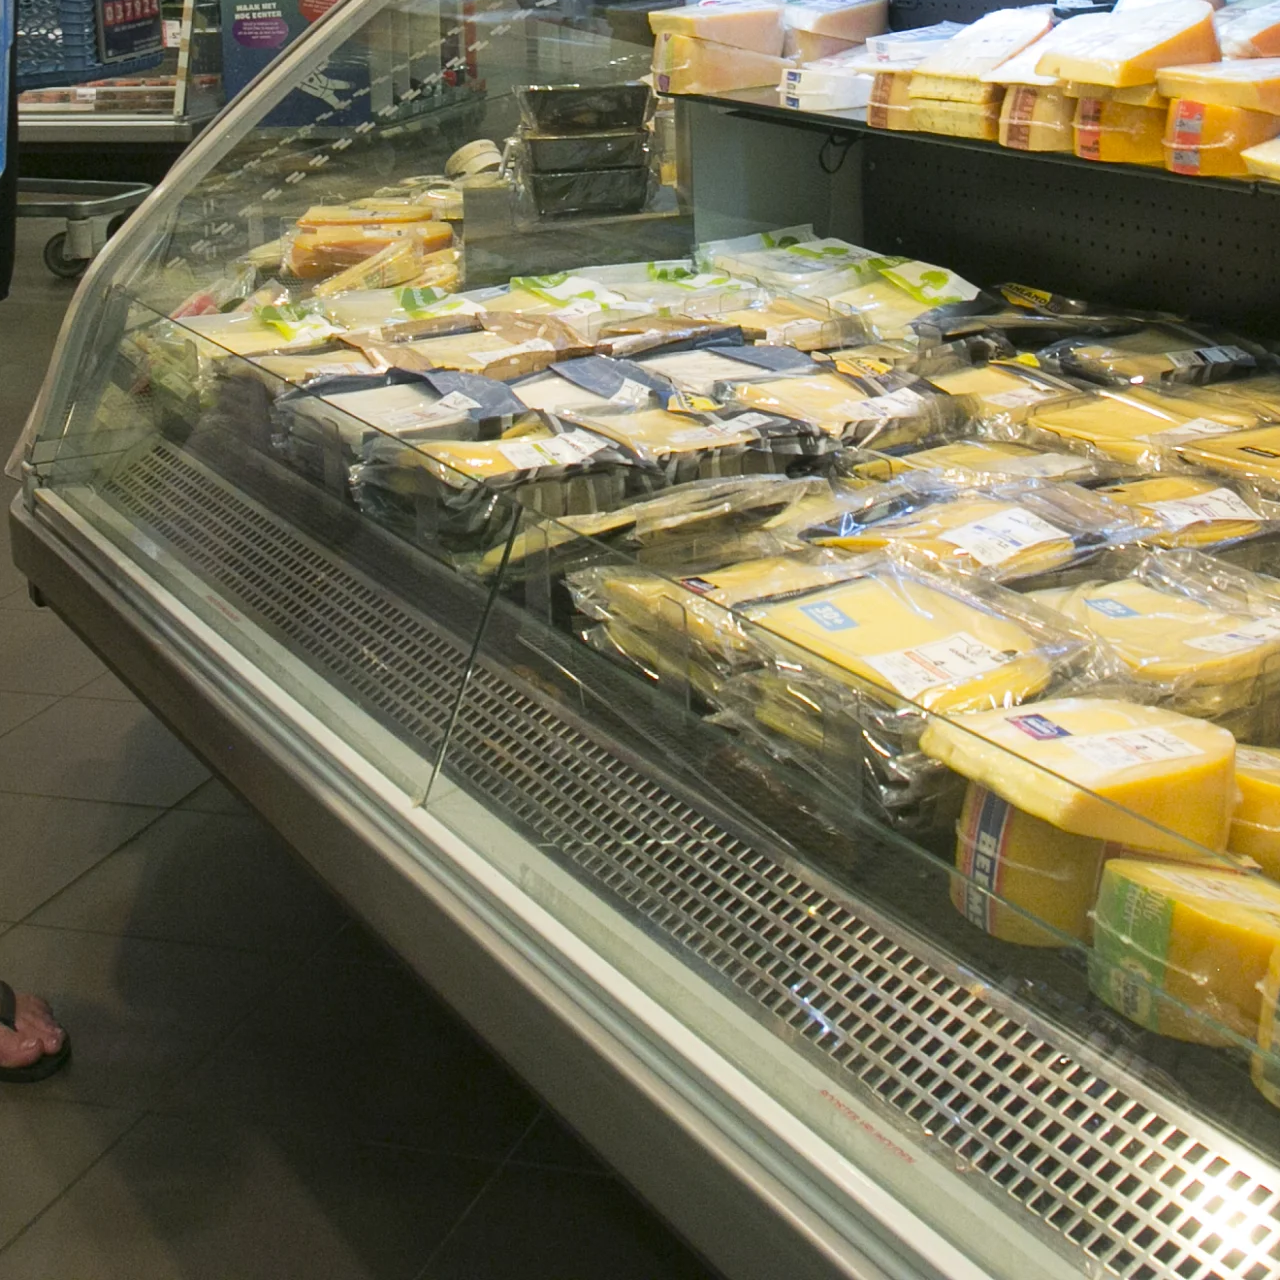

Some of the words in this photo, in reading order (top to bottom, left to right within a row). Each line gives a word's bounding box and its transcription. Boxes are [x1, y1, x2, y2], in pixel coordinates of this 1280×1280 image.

[236, 3, 261, 12] MAAK
[262, 2, 277, 11] HET
[234, 12, 251, 20] NOG
[252, 11, 282, 20] ECHTER
